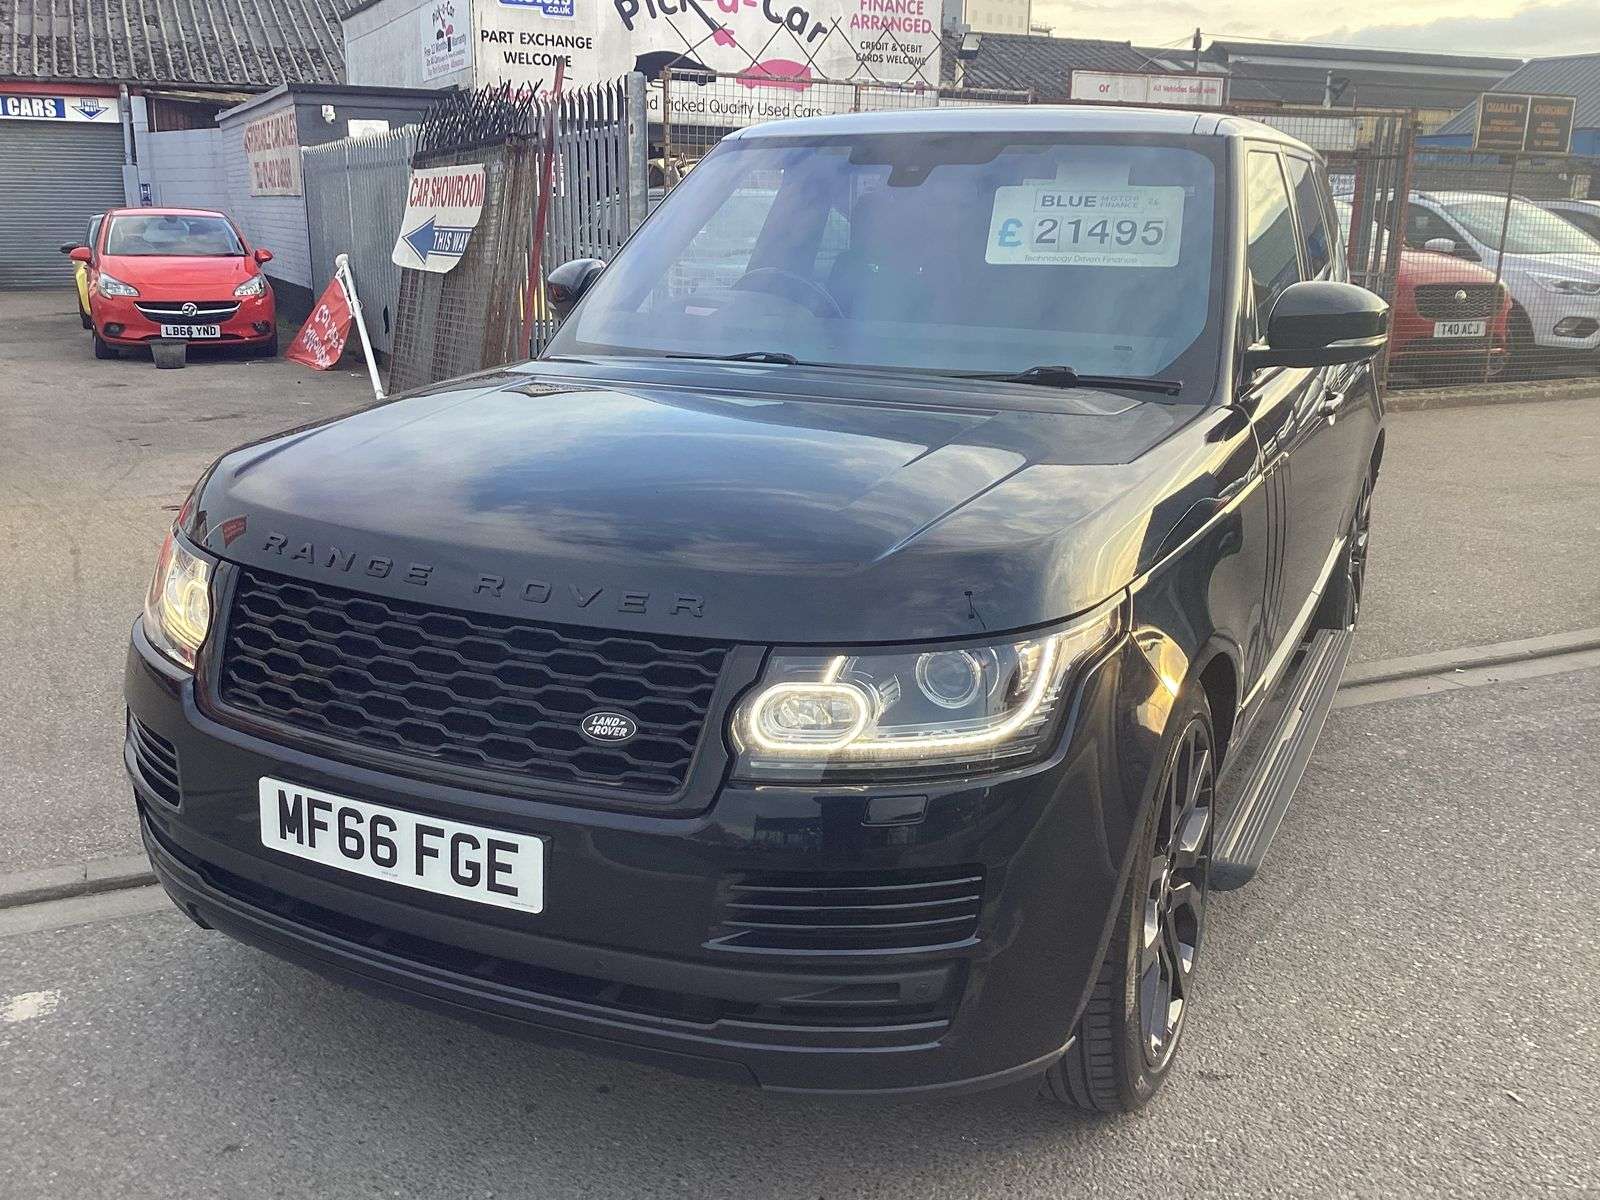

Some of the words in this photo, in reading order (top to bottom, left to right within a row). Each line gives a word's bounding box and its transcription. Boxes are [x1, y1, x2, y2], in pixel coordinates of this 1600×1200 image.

[546, 5, 571, 14] .co.uk
[860, 0, 924, 15] FINANCE
[850, 14, 932, 33] ARRANGED
[481, 30, 514, 44] PART
[520, 32, 592, 49] EXCHANGE
[860, 41, 889, 51] CREDIT
[892, 43, 898, 52] &
[901, 44, 922, 53] DEBIT
[856, 53, 884, 63] CARDS
[886, 55, 926, 65] WELCOME
[7, 97, 57, 117] CARS
[671, 96, 704, 113] icked
[709, 98, 753, 117] Quality
[757, 101, 790, 117] Used
[793, 103, 822, 117] Cars
[410, 178, 430, 207] CAR
[430, 173, 484, 208] SHOWROOM
[1041, 195, 1097, 208] BLUE
[998, 217, 1023, 247] £
[1035, 218, 1164, 246] 21495
[433, 232, 452, 251] THIS
[452, 233, 471, 254] WAY
[1024, 254, 1073, 264] Technology
[165, 326, 193, 336] LB66
[195, 326, 217, 336] YND
[1442, 323, 1459, 335] T40
[263, 531, 434, 587] RANGE
[472, 573, 706, 618] ROVER
[277, 789, 398, 869] MF66
[415, 823, 519, 897] FGE
